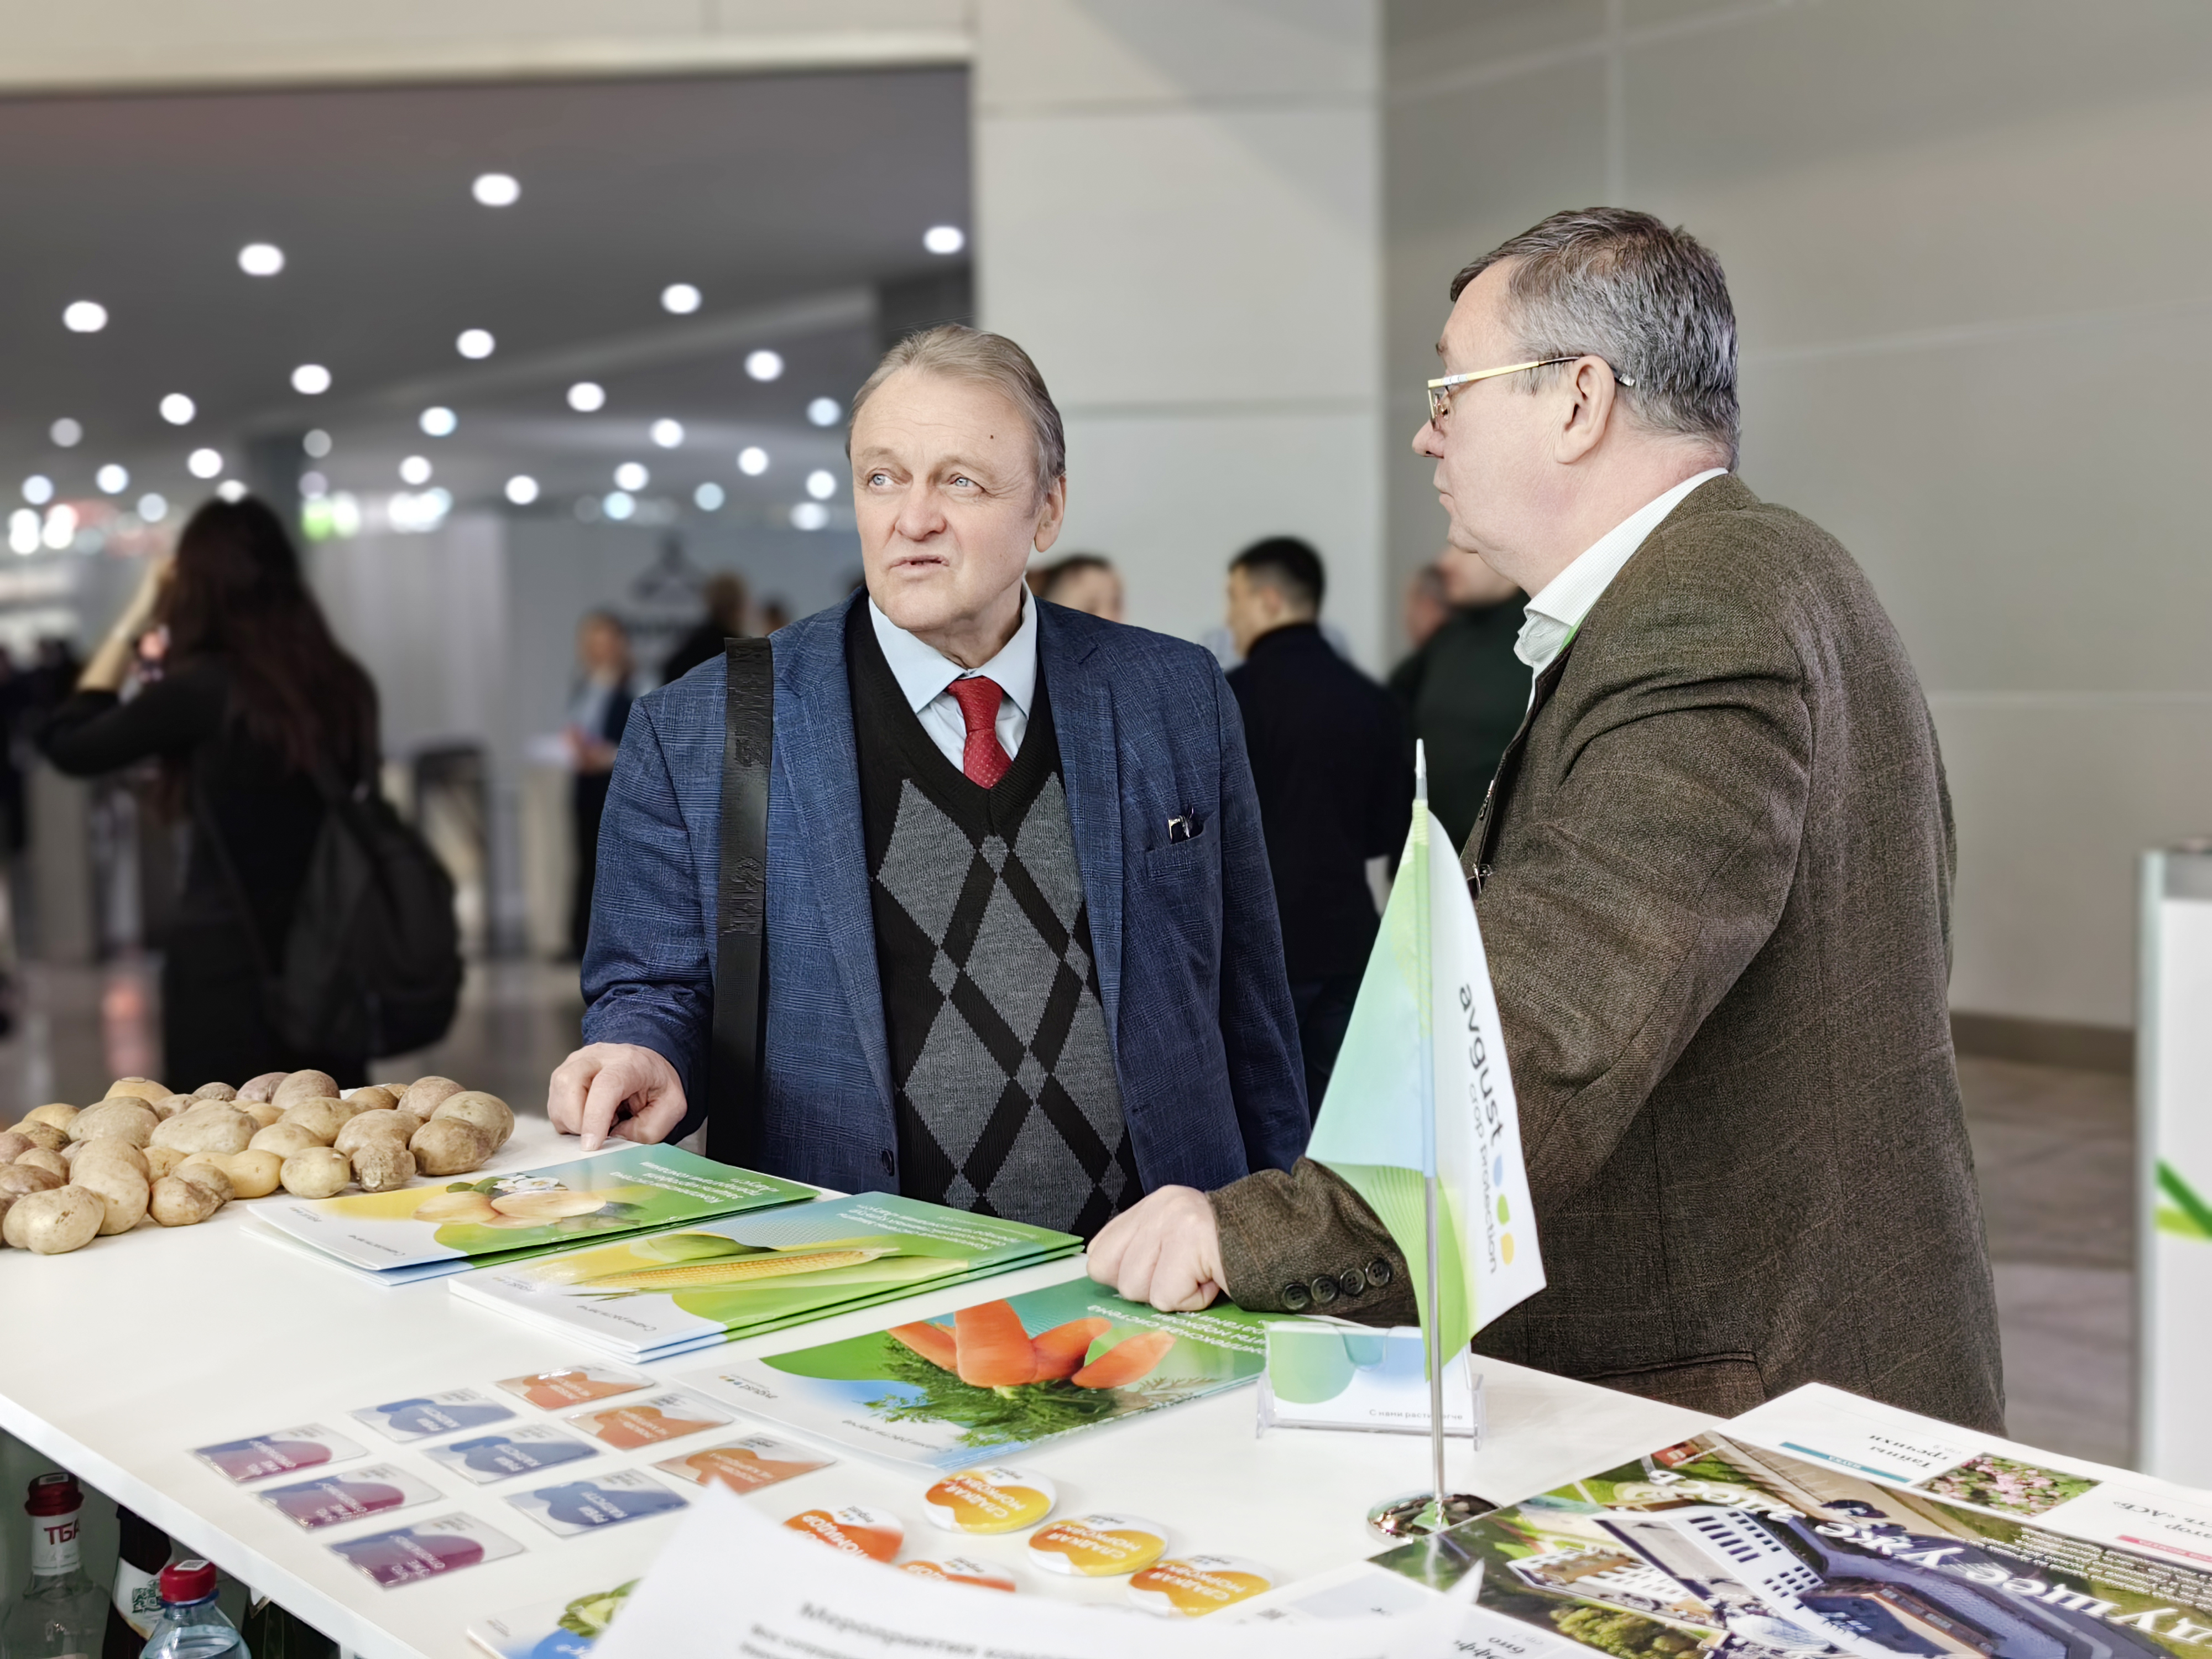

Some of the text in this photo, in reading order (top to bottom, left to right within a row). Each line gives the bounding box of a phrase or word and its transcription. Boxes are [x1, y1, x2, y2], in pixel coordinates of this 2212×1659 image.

[1460, 982, 1504, 1146] avgust
[1469, 1083, 1497, 1274] crop protection
[1087, 1305, 1264, 1356] мплексная система
[1150, 1313, 1231, 1337] моркови
[740, 1384, 778, 1400] avgust
[1867, 1446, 1932, 1469] Тайны
[1868, 1435, 1949, 1460] гречихи
[944, 1484, 1009, 1519] СЛАДКАЯ
[954, 1475, 1026, 1511] МОРКОВКА
[1045, 1532, 1127, 1559] СЛАДКАЯ
[1052, 1522, 1141, 1553] МОРКОВКА
[2164, 1525, 2212, 1538] атор
[1149, 1571, 1230, 1601] СЛАДКАЯ
[1156, 1562, 1247, 1594] МОРКОВКА
[1965, 1566, 2212, 1649] дущее
